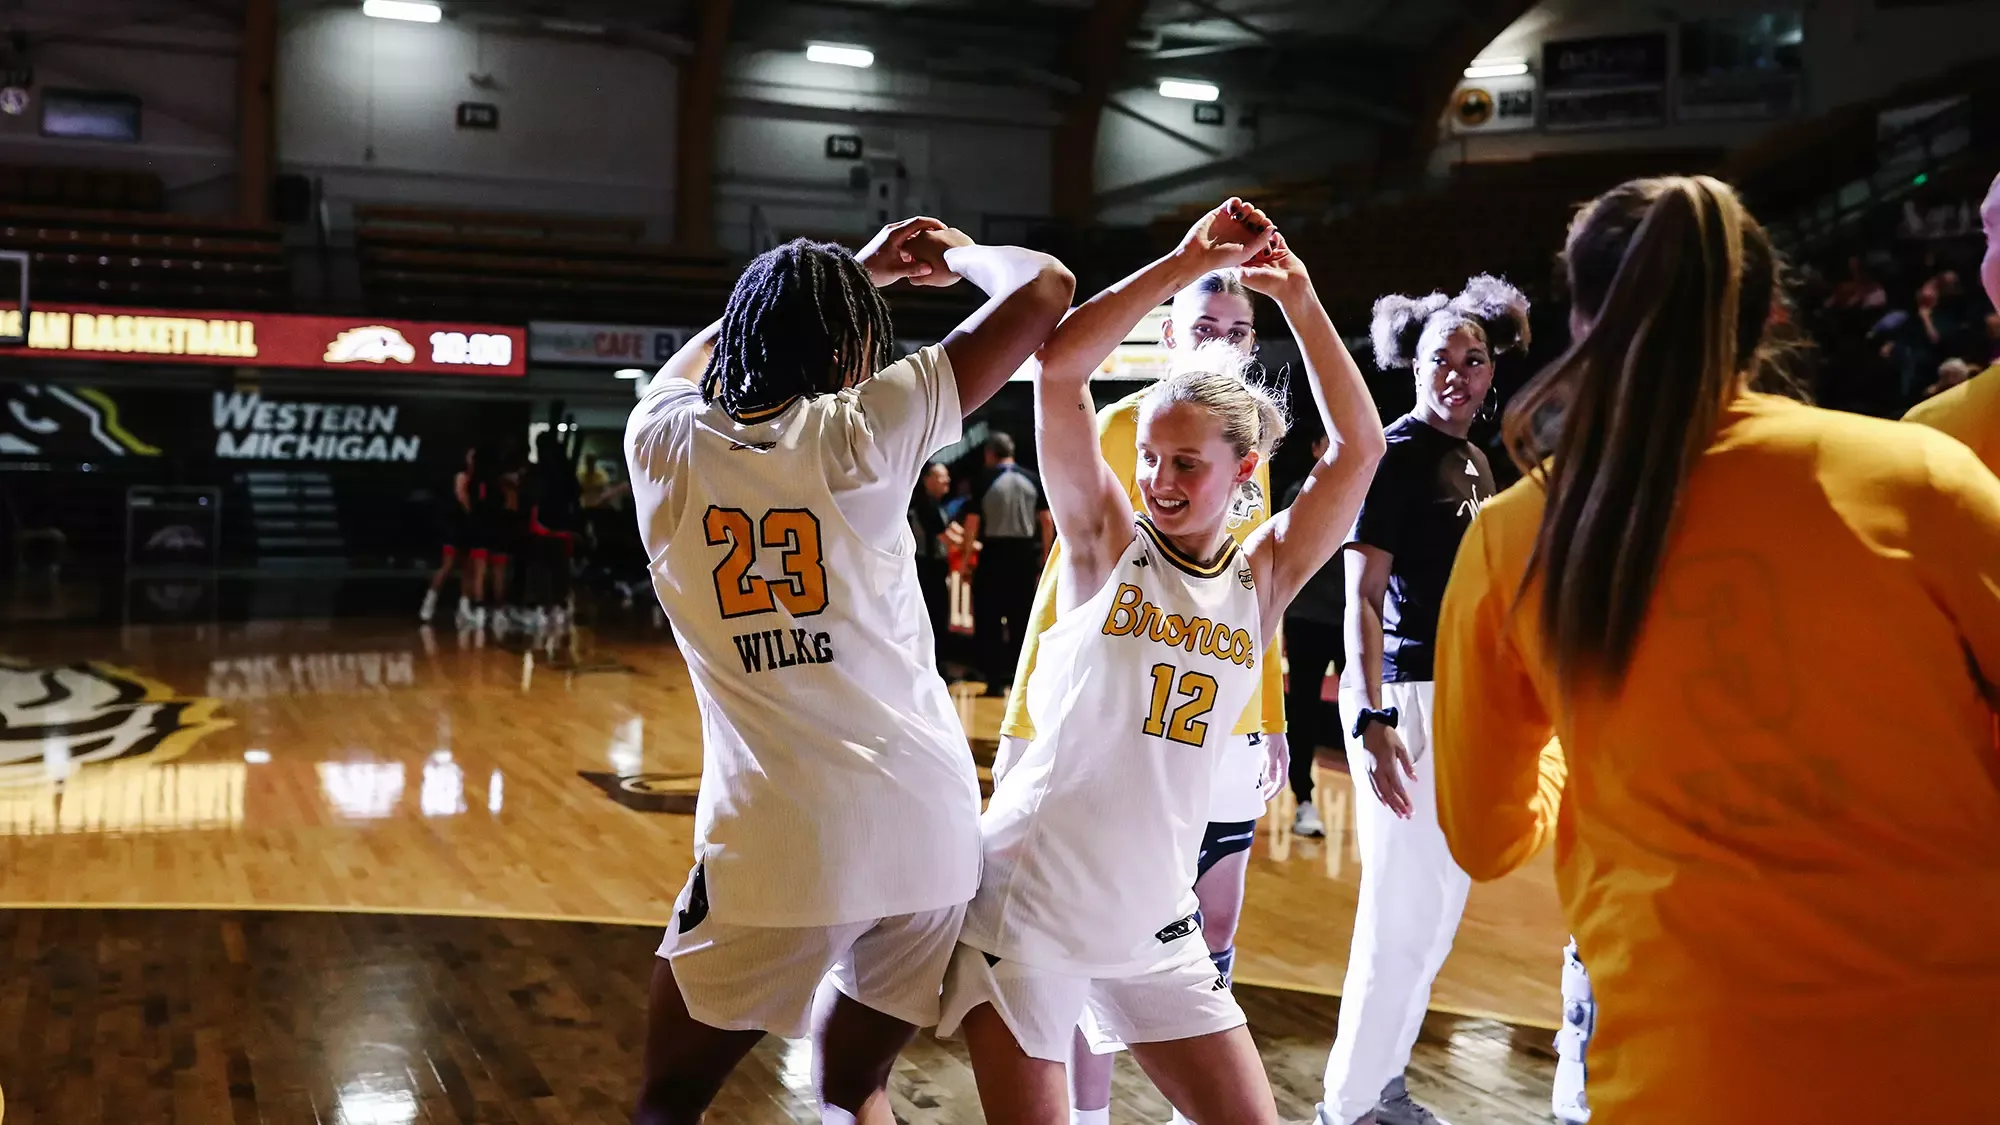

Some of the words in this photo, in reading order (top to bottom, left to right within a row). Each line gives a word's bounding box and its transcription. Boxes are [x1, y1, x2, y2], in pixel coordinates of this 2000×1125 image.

[72, 313, 258, 357] BASKETBALL
[429, 331, 512, 366] 10:00
[594, 332, 643, 360] CAFE
[213, 391, 398, 433] WESTERN
[215, 431, 420, 462] MICHIGAN
[703, 505, 829, 619] 23
[1142, 663, 1218, 748] 12
